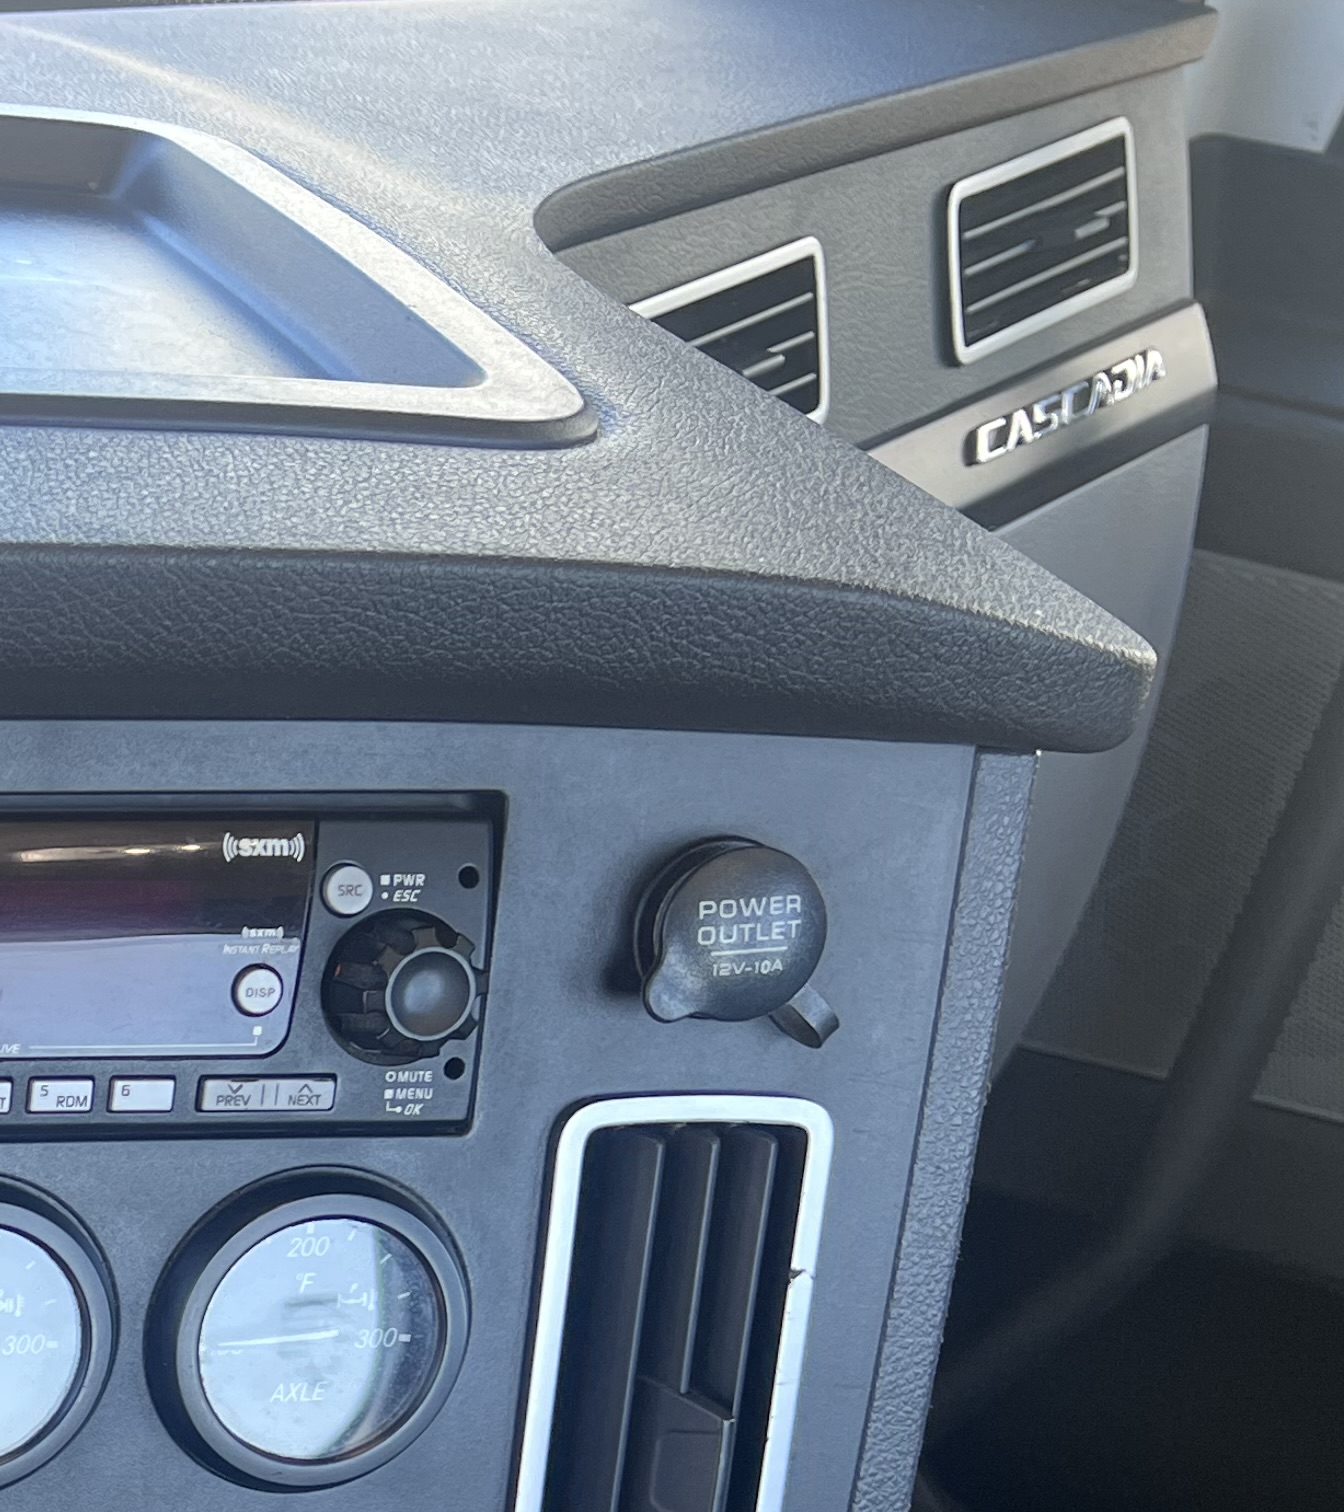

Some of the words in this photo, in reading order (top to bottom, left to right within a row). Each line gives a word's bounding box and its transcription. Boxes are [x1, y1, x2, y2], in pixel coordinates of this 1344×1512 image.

[976, 349, 1166, 463] CASCADIA
[393, 874, 426, 887] PWR
[337, 884, 363, 896] SRC
[392, 889, 421, 902] ESC
[698, 894, 802, 921] POWER
[696, 919, 802, 946] OUTLET
[712, 958, 784, 977] 12V-10A
[245, 986, 276, 998] DISP
[397, 1071, 433, 1083] MUTE
[40, 1085, 49, 1097] 5
[121, 1085, 130, 1097] 6
[395, 1088, 433, 1100] MENU
[56, 1096, 87, 1108] RDM
[216, 1095, 251, 1107] PREV
[288, 1095, 322, 1106] NEXT
[403, 1103, 424, 1115] OK
[286, 1237, 329, 1258] 200
[1, 1334, 46, 1356] 300
[353, 1328, 398, 1350] 300
[270, 1381, 327, 1403] AXLE
